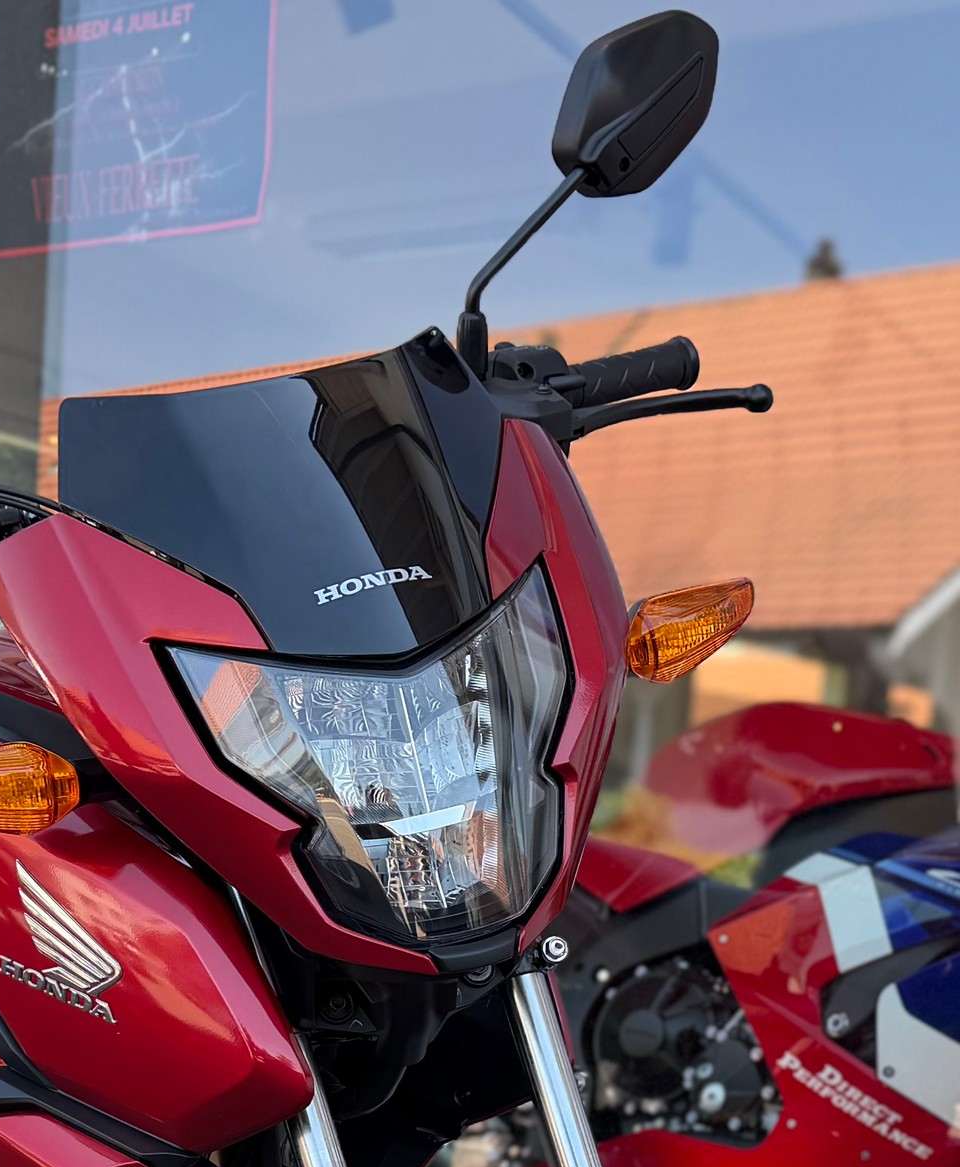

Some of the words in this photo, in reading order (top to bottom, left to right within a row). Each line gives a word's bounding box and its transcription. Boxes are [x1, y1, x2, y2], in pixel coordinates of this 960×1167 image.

[43, 19, 110, 49] SAMEDI
[112, 16, 124, 35] 4
[127, 3, 195, 34] JUILLET
[313, 565, 433, 605] HONDA
[0, 954, 119, 1024] HONDA
[776, 1051, 935, 1161] PERFORMANCE
[816, 1063, 904, 1127] DIRECT
